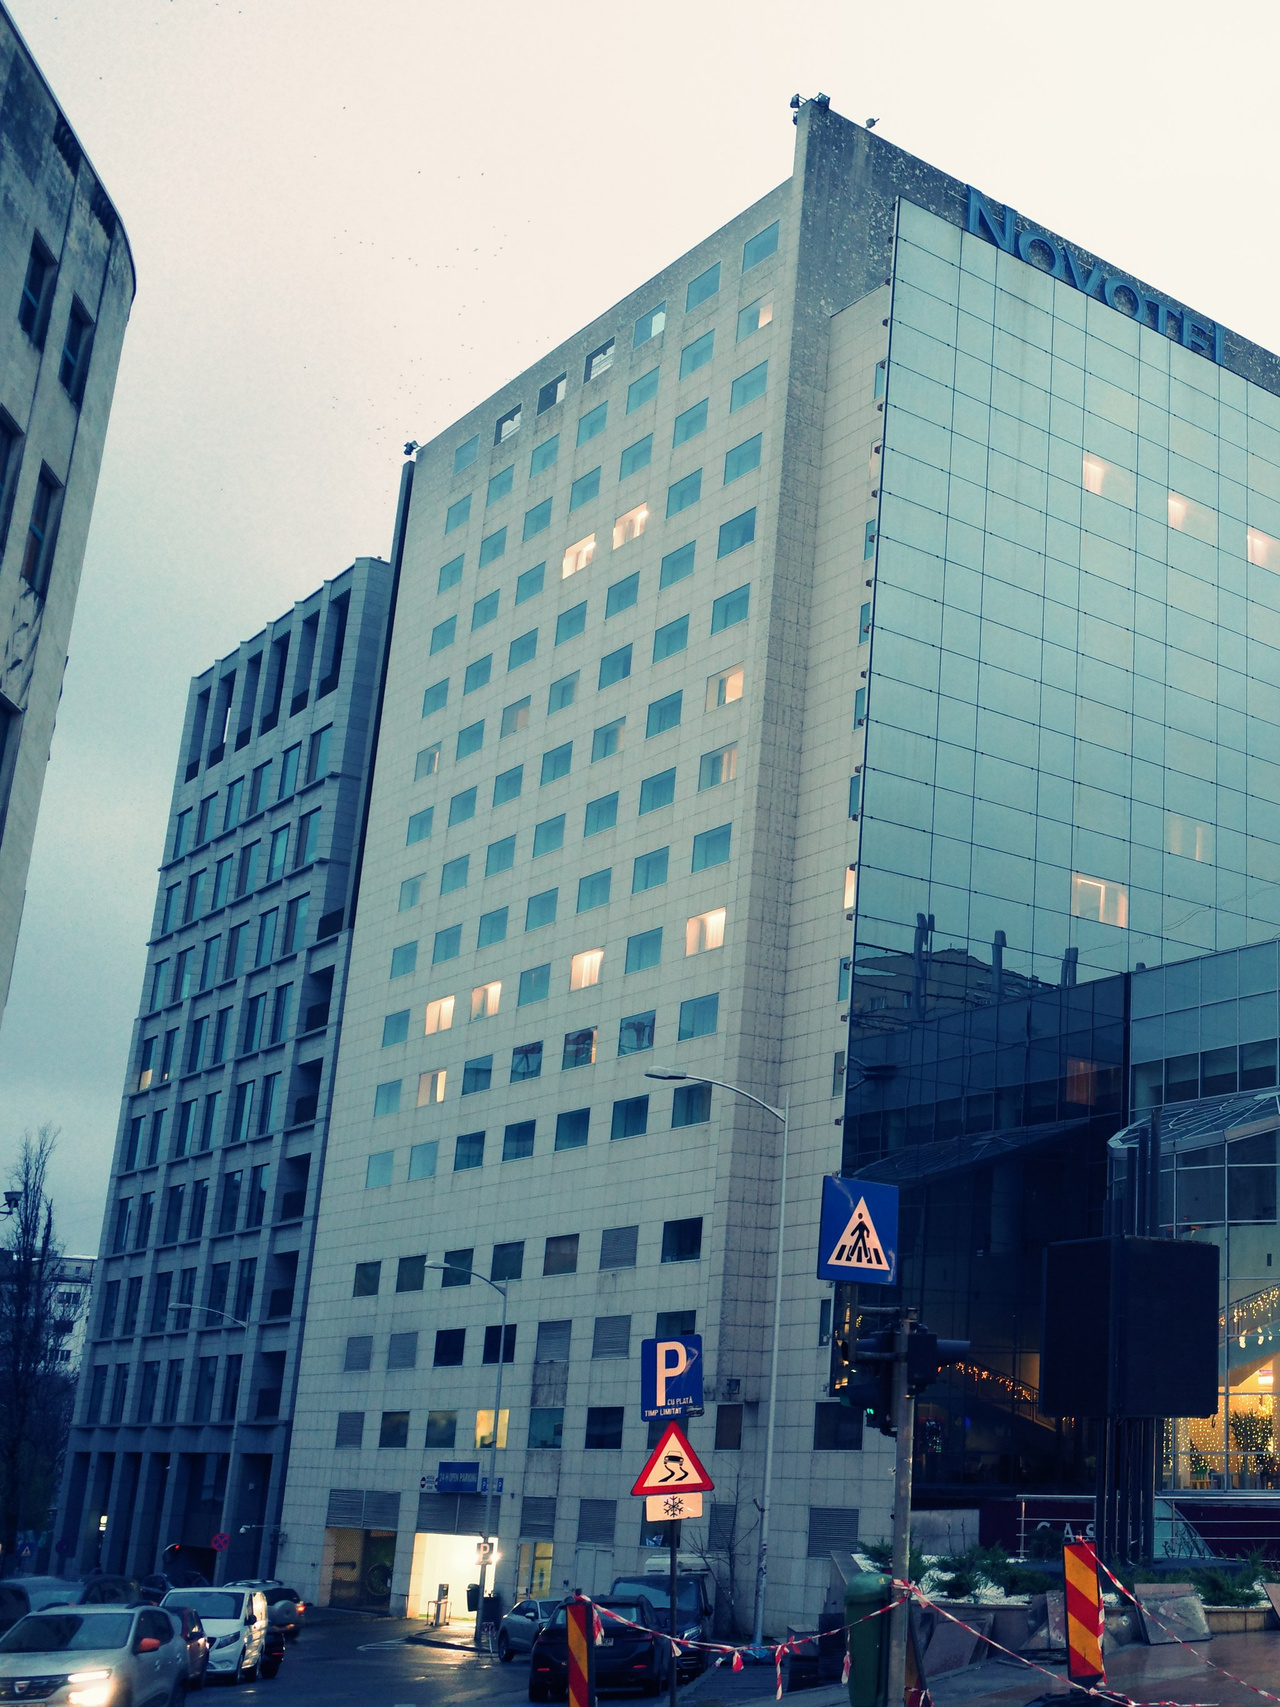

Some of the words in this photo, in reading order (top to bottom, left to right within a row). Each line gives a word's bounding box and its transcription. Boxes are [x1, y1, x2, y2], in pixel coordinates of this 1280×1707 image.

[656, 1341, 687, 1406] P
[667, 1398, 675, 1406] CU
[645, 1409, 659, 1417] TIMP
[660, 1407, 682, 1416] LIMITAT
